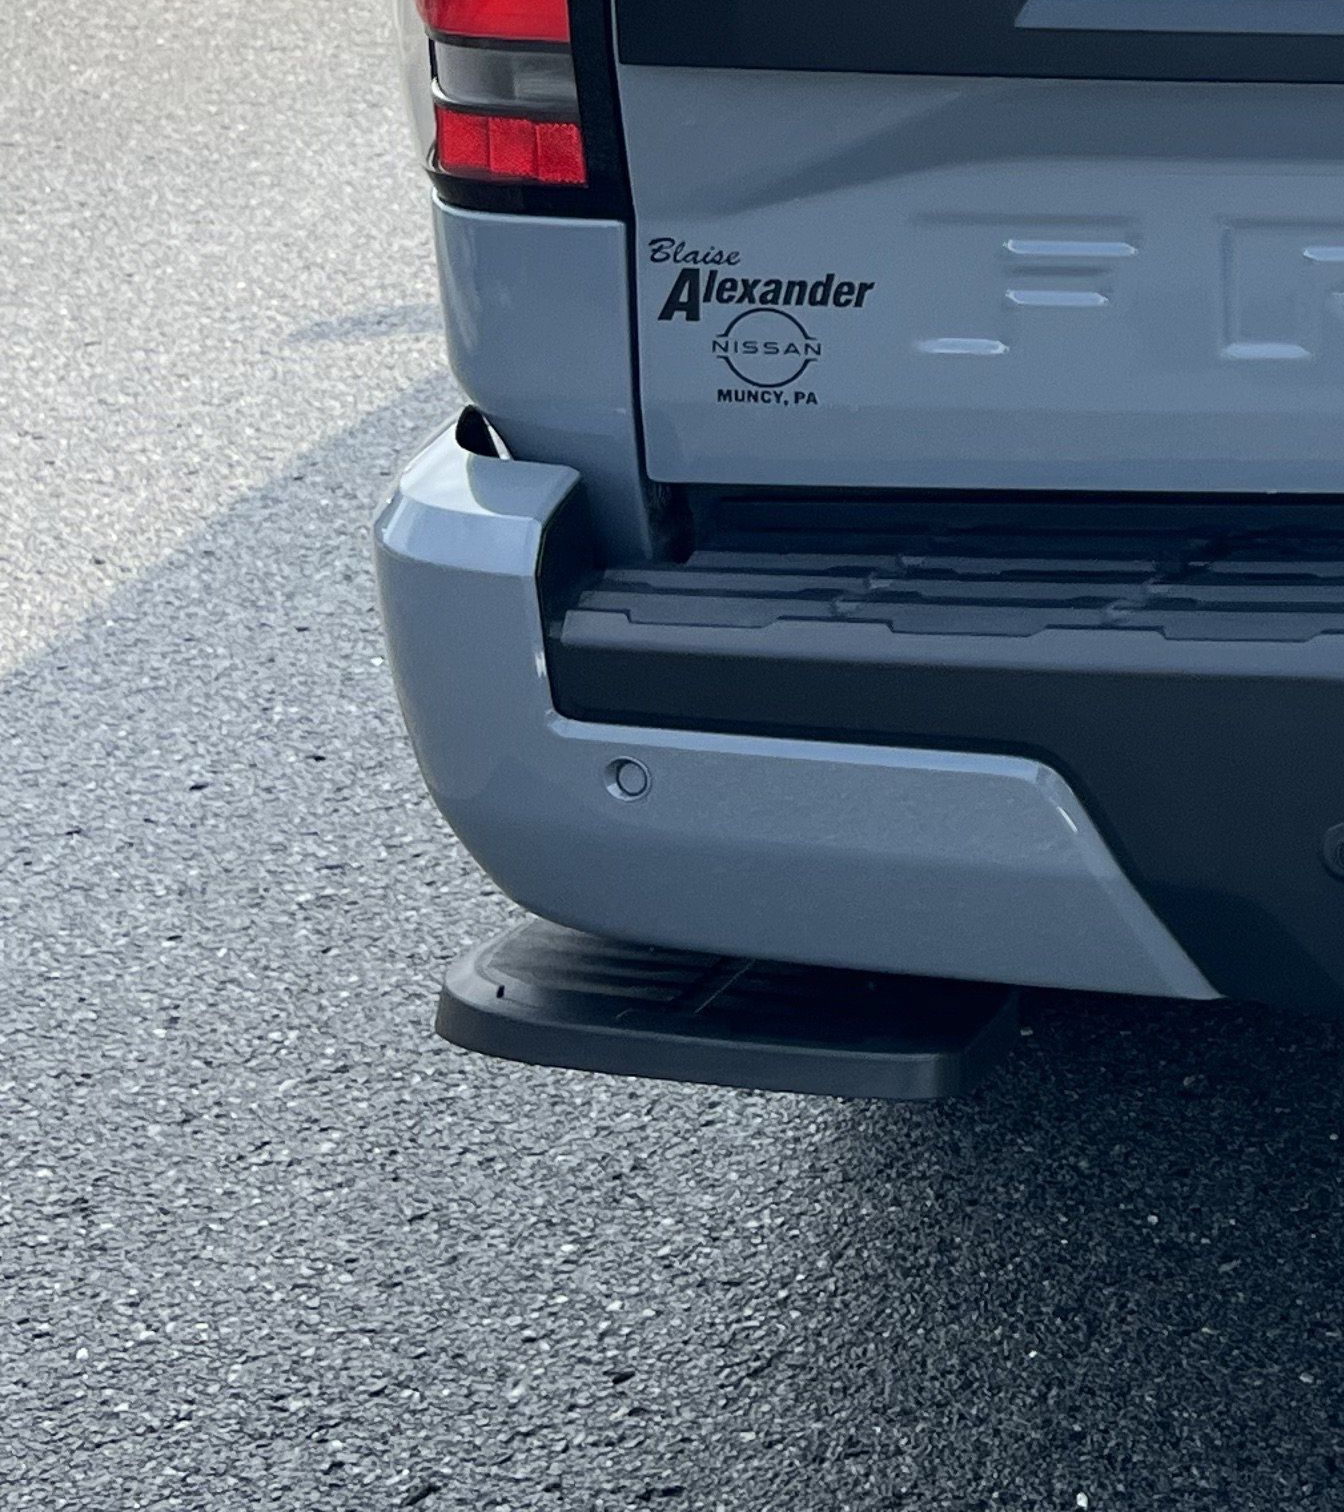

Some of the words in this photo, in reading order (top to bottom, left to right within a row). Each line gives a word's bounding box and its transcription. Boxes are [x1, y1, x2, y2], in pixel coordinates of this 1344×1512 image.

[649, 237, 741, 267] Blaise
[657, 267, 876, 322] Alexander
[711, 339, 822, 357] NISSAN
[717, 389, 789, 406] MUNCY,
[794, 391, 818, 405] PA
